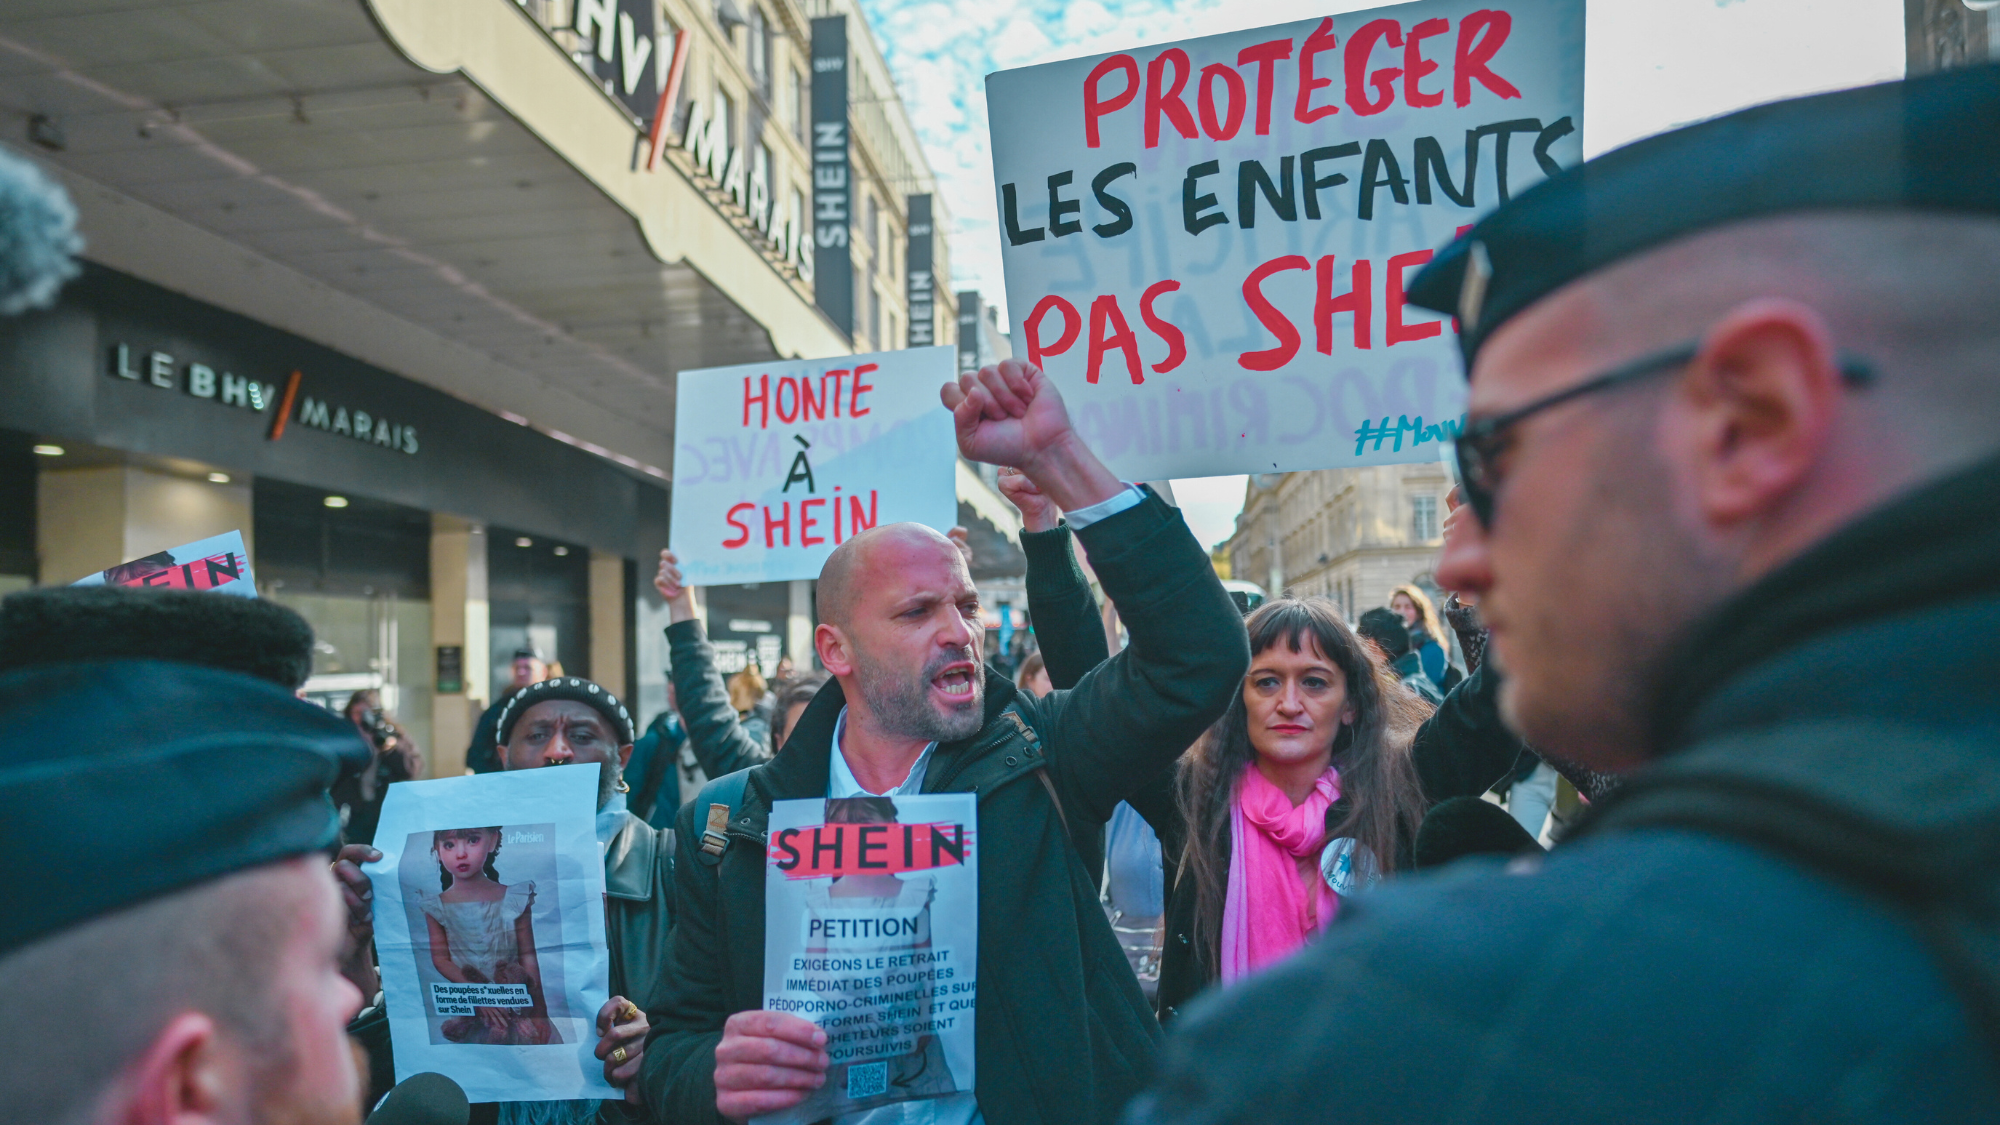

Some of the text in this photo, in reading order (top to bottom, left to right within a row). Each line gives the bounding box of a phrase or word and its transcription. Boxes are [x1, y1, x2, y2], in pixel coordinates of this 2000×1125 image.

[1083, 9, 1522, 149] PROTÉGER
[685, 92, 814, 283] MARAIS
[814, 121, 848, 249] SHEIN
[1002, 162, 1137, 247] LES
[1023, 223, 1474, 385] PAS SHE
[115, 342, 420, 456] LE BHV MARAIS
[742, 363, 879, 429] HONTE
[782, 434, 815, 494] À
[507, 831, 545, 844] Le Parisien
[776, 823, 965, 871] SHEIN
[809, 916, 918, 938] PETITION
[794, 950, 950, 971] EXIGEONS LE RETRAIT
[433, 984, 448, 994] Des
[449, 985, 479, 995] poupées
[515, 987, 525, 995] en
[786, 967, 954, 992] IMMÉDIAT DES POUPÉES
[435, 996, 529, 1005] forme de fillettes vendues
[450, 1005, 472, 1013] Shein
[769, 983, 948, 1012] PÉDOPORNO-CRIMINELLES
[878, 1007, 921, 1021] SHEIN
[929, 1001, 945, 1014] ET
[903, 1017, 955, 1034] SOIENT
